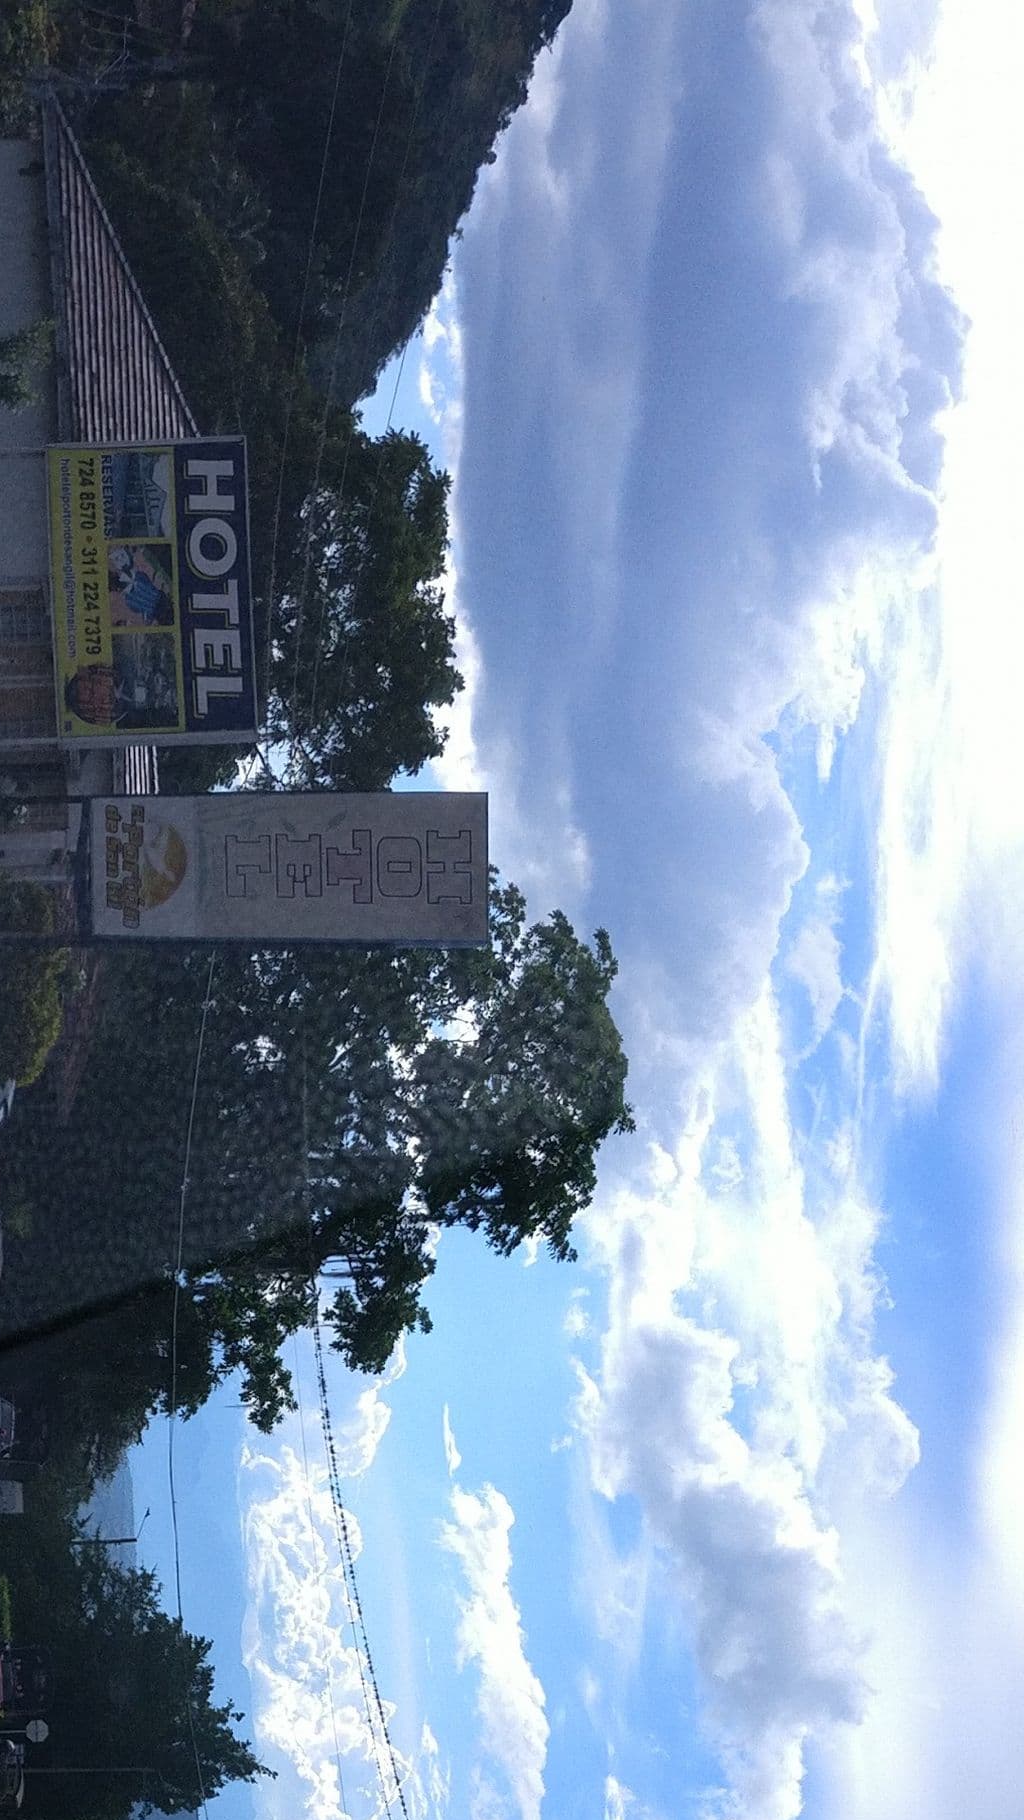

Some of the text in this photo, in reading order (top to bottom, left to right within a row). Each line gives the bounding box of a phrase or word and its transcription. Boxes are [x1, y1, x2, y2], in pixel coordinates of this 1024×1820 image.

[100, 454, 114, 541] RESERVAS:
[78, 458, 102, 655] 724 8570 311 224 7379
[184, 459, 243, 719] HOTEL
[105, 805, 122, 833] de
[106, 836, 121, 878] San
[225, 829, 472, 904] HOTEL
